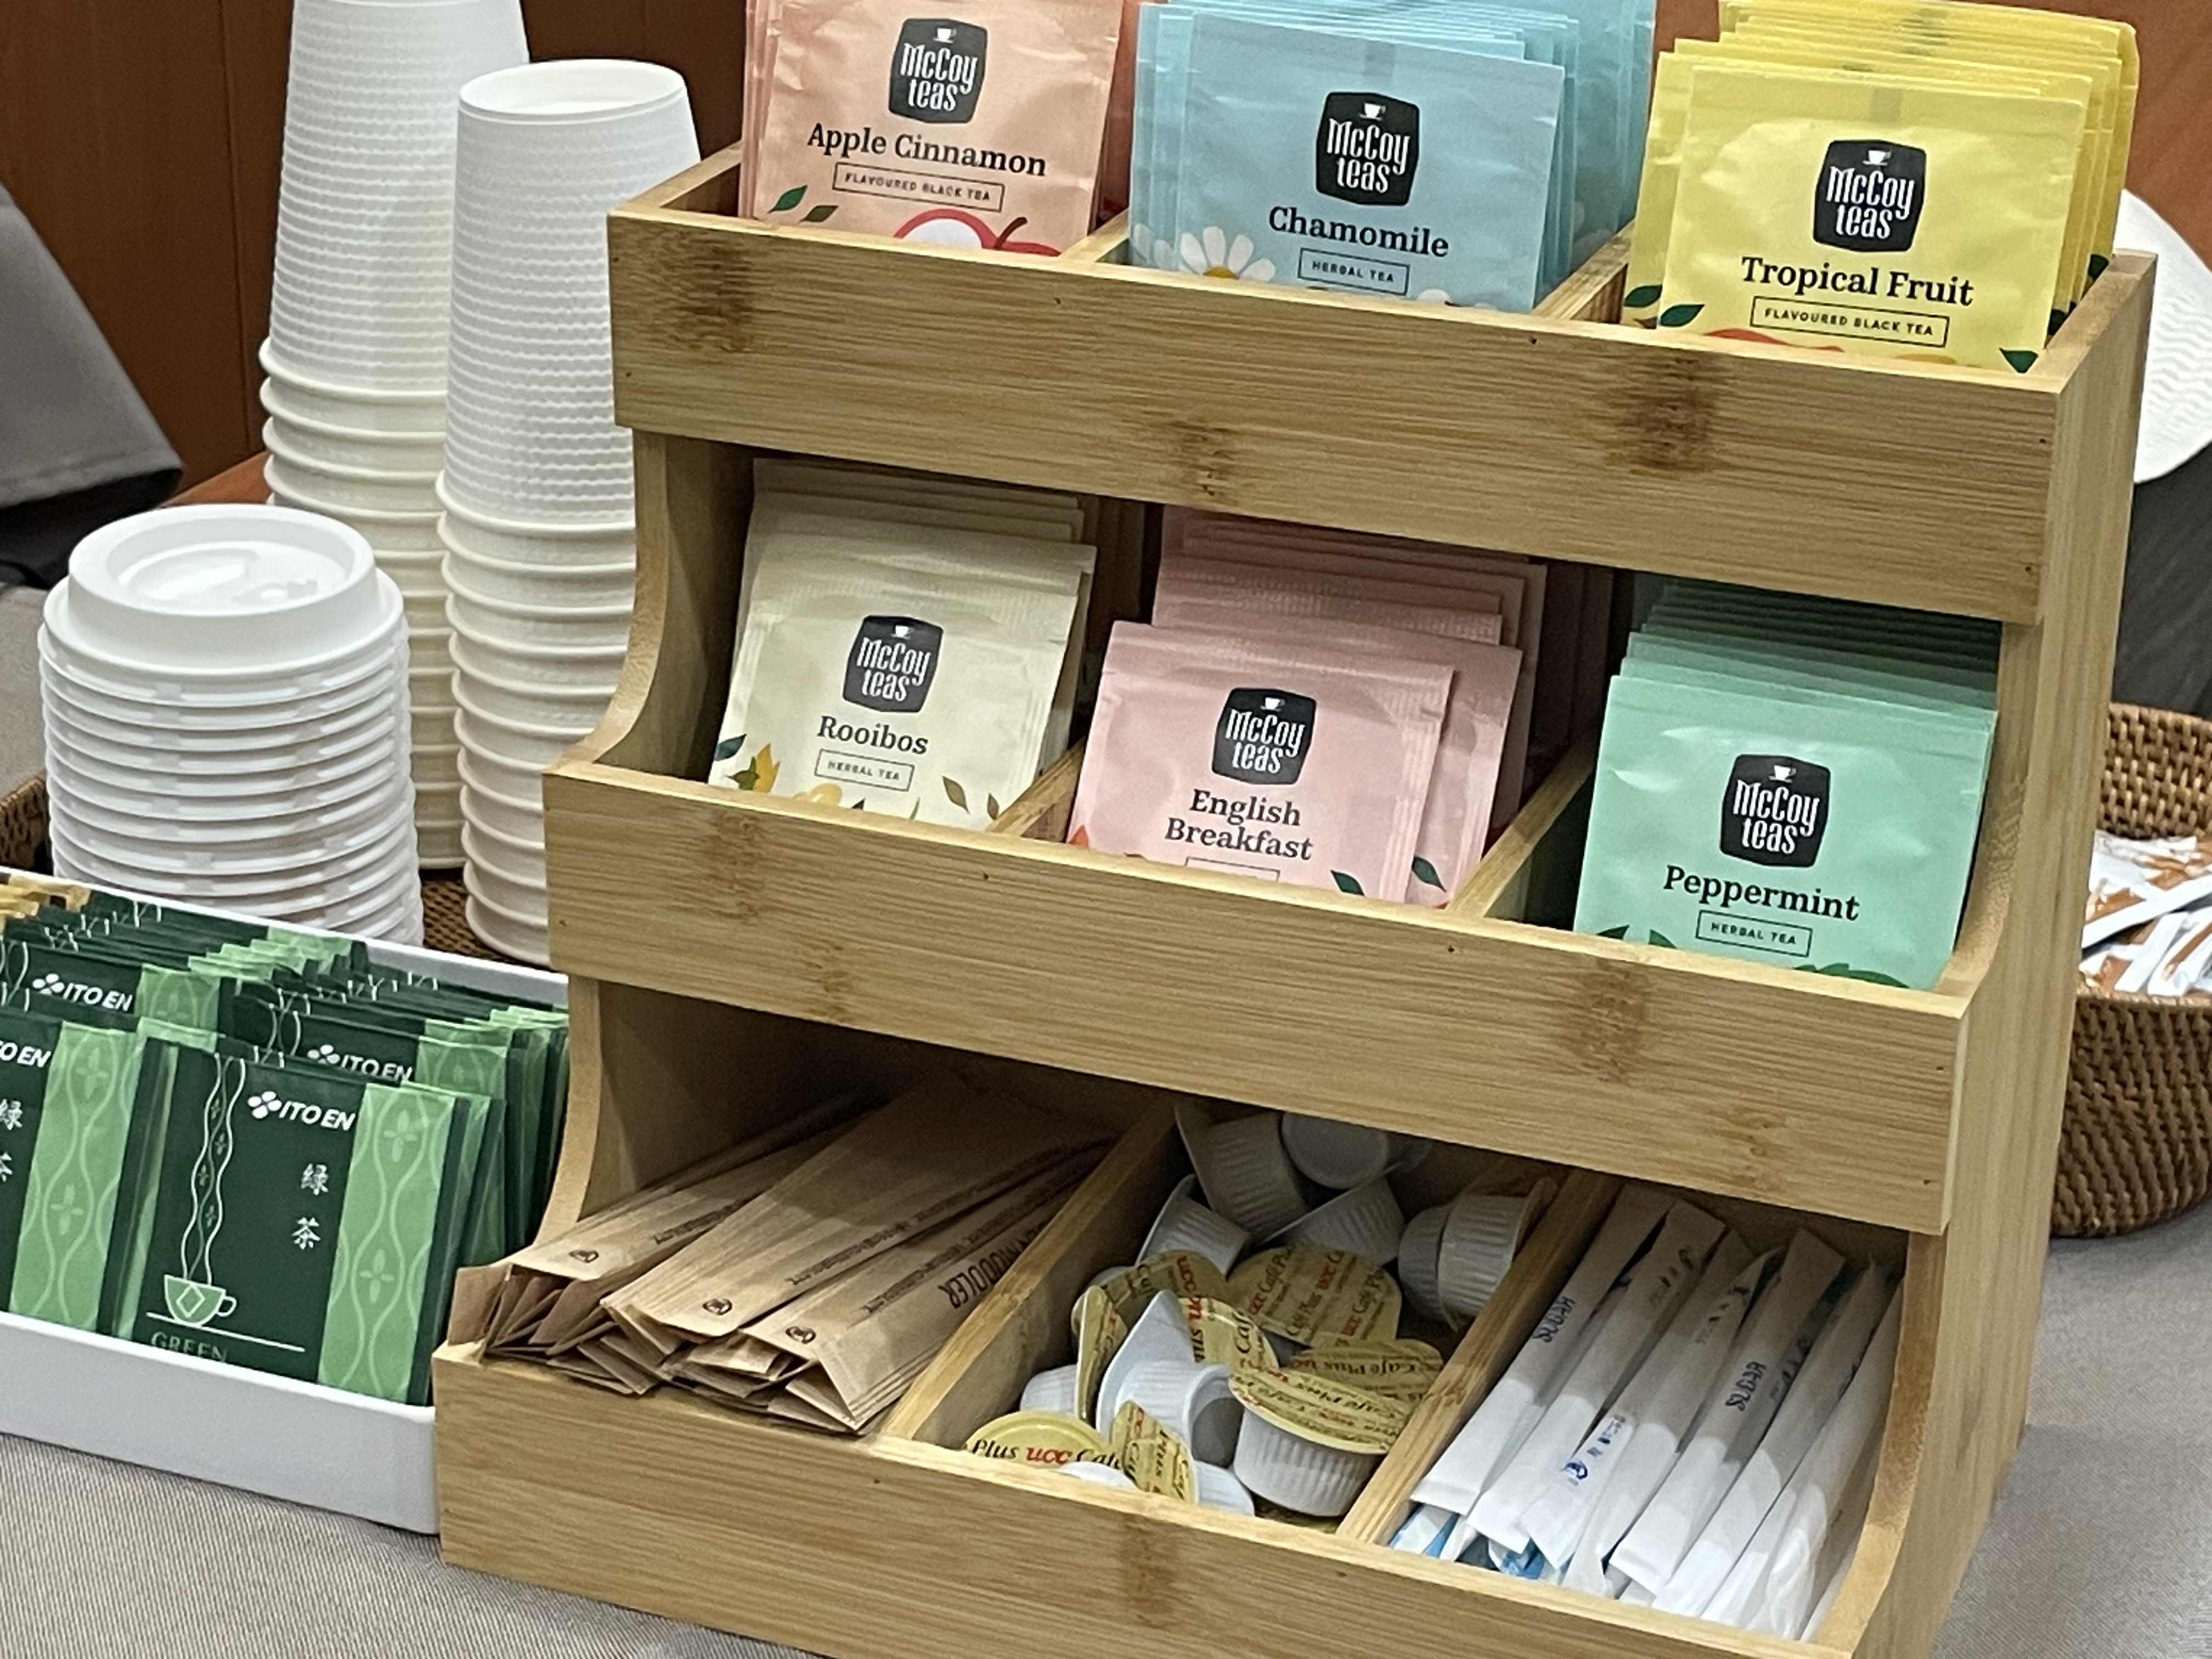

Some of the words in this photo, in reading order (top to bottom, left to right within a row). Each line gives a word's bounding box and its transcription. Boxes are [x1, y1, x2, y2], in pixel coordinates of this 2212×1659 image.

[900, 43, 978, 94] McCoy
[907, 78, 958, 111] teas
[807, 122, 887, 159] Apple
[894, 133, 1046, 177] Cinnamon
[1326, 117, 1411, 176] McCoy
[844, 173, 918, 191] FLAVOURED
[922, 183, 962, 199] BLACK
[967, 188, 991, 201] TEA
[1336, 156, 1390, 194] teas
[1826, 166, 1916, 220] McCoy
[1268, 206, 1451, 258] Chamomile
[1836, 204, 1892, 239] teas
[1311, 260, 1364, 280] HERBAL
[1369, 268, 1395, 284] TEA
[1741, 256, 1879, 296] Tropical
[1886, 270, 1975, 308] Fruit
[1764, 307, 1848, 328] FLAVOURED
[1854, 318, 1901, 334] BLACK
[1906, 324, 1934, 337] TEA
[856, 636, 932, 686] McCoy
[861, 669, 912, 702] teas
[816, 715, 929, 755] Rooibos
[1225, 708, 1306, 758] McCoy
[827, 760, 873, 777] HERBAL
[878, 768, 900, 781] TEA
[1232, 742, 1285, 774] teas
[1189, 788, 1302, 827] English
[1733, 779, 1820, 837] McCoy
[1165, 817, 1313, 860] Breakfast
[1741, 817, 1798, 854] teas
[1662, 865, 1860, 921] Peppermint
[1711, 922, 1764, 941] HERBAL
[1771, 930, 1797, 945] TEA
[63, 983, 104, 1005] ITO
[101, 990, 133, 1011] EN
[17, 1046, 52, 1068] EN
[341, 1054, 380, 1076] ITO
[382, 1063, 413, 1081] EN
[279, 1101, 323, 1124] ITO
[320, 1109, 356, 1131] EN
[291, 1163, 329, 1250] 緑茶
[151, 1331, 228, 1362] GREEN
[970, 1438, 1022, 1460] Plus
[1025, 1446, 1074, 1465] ucc
